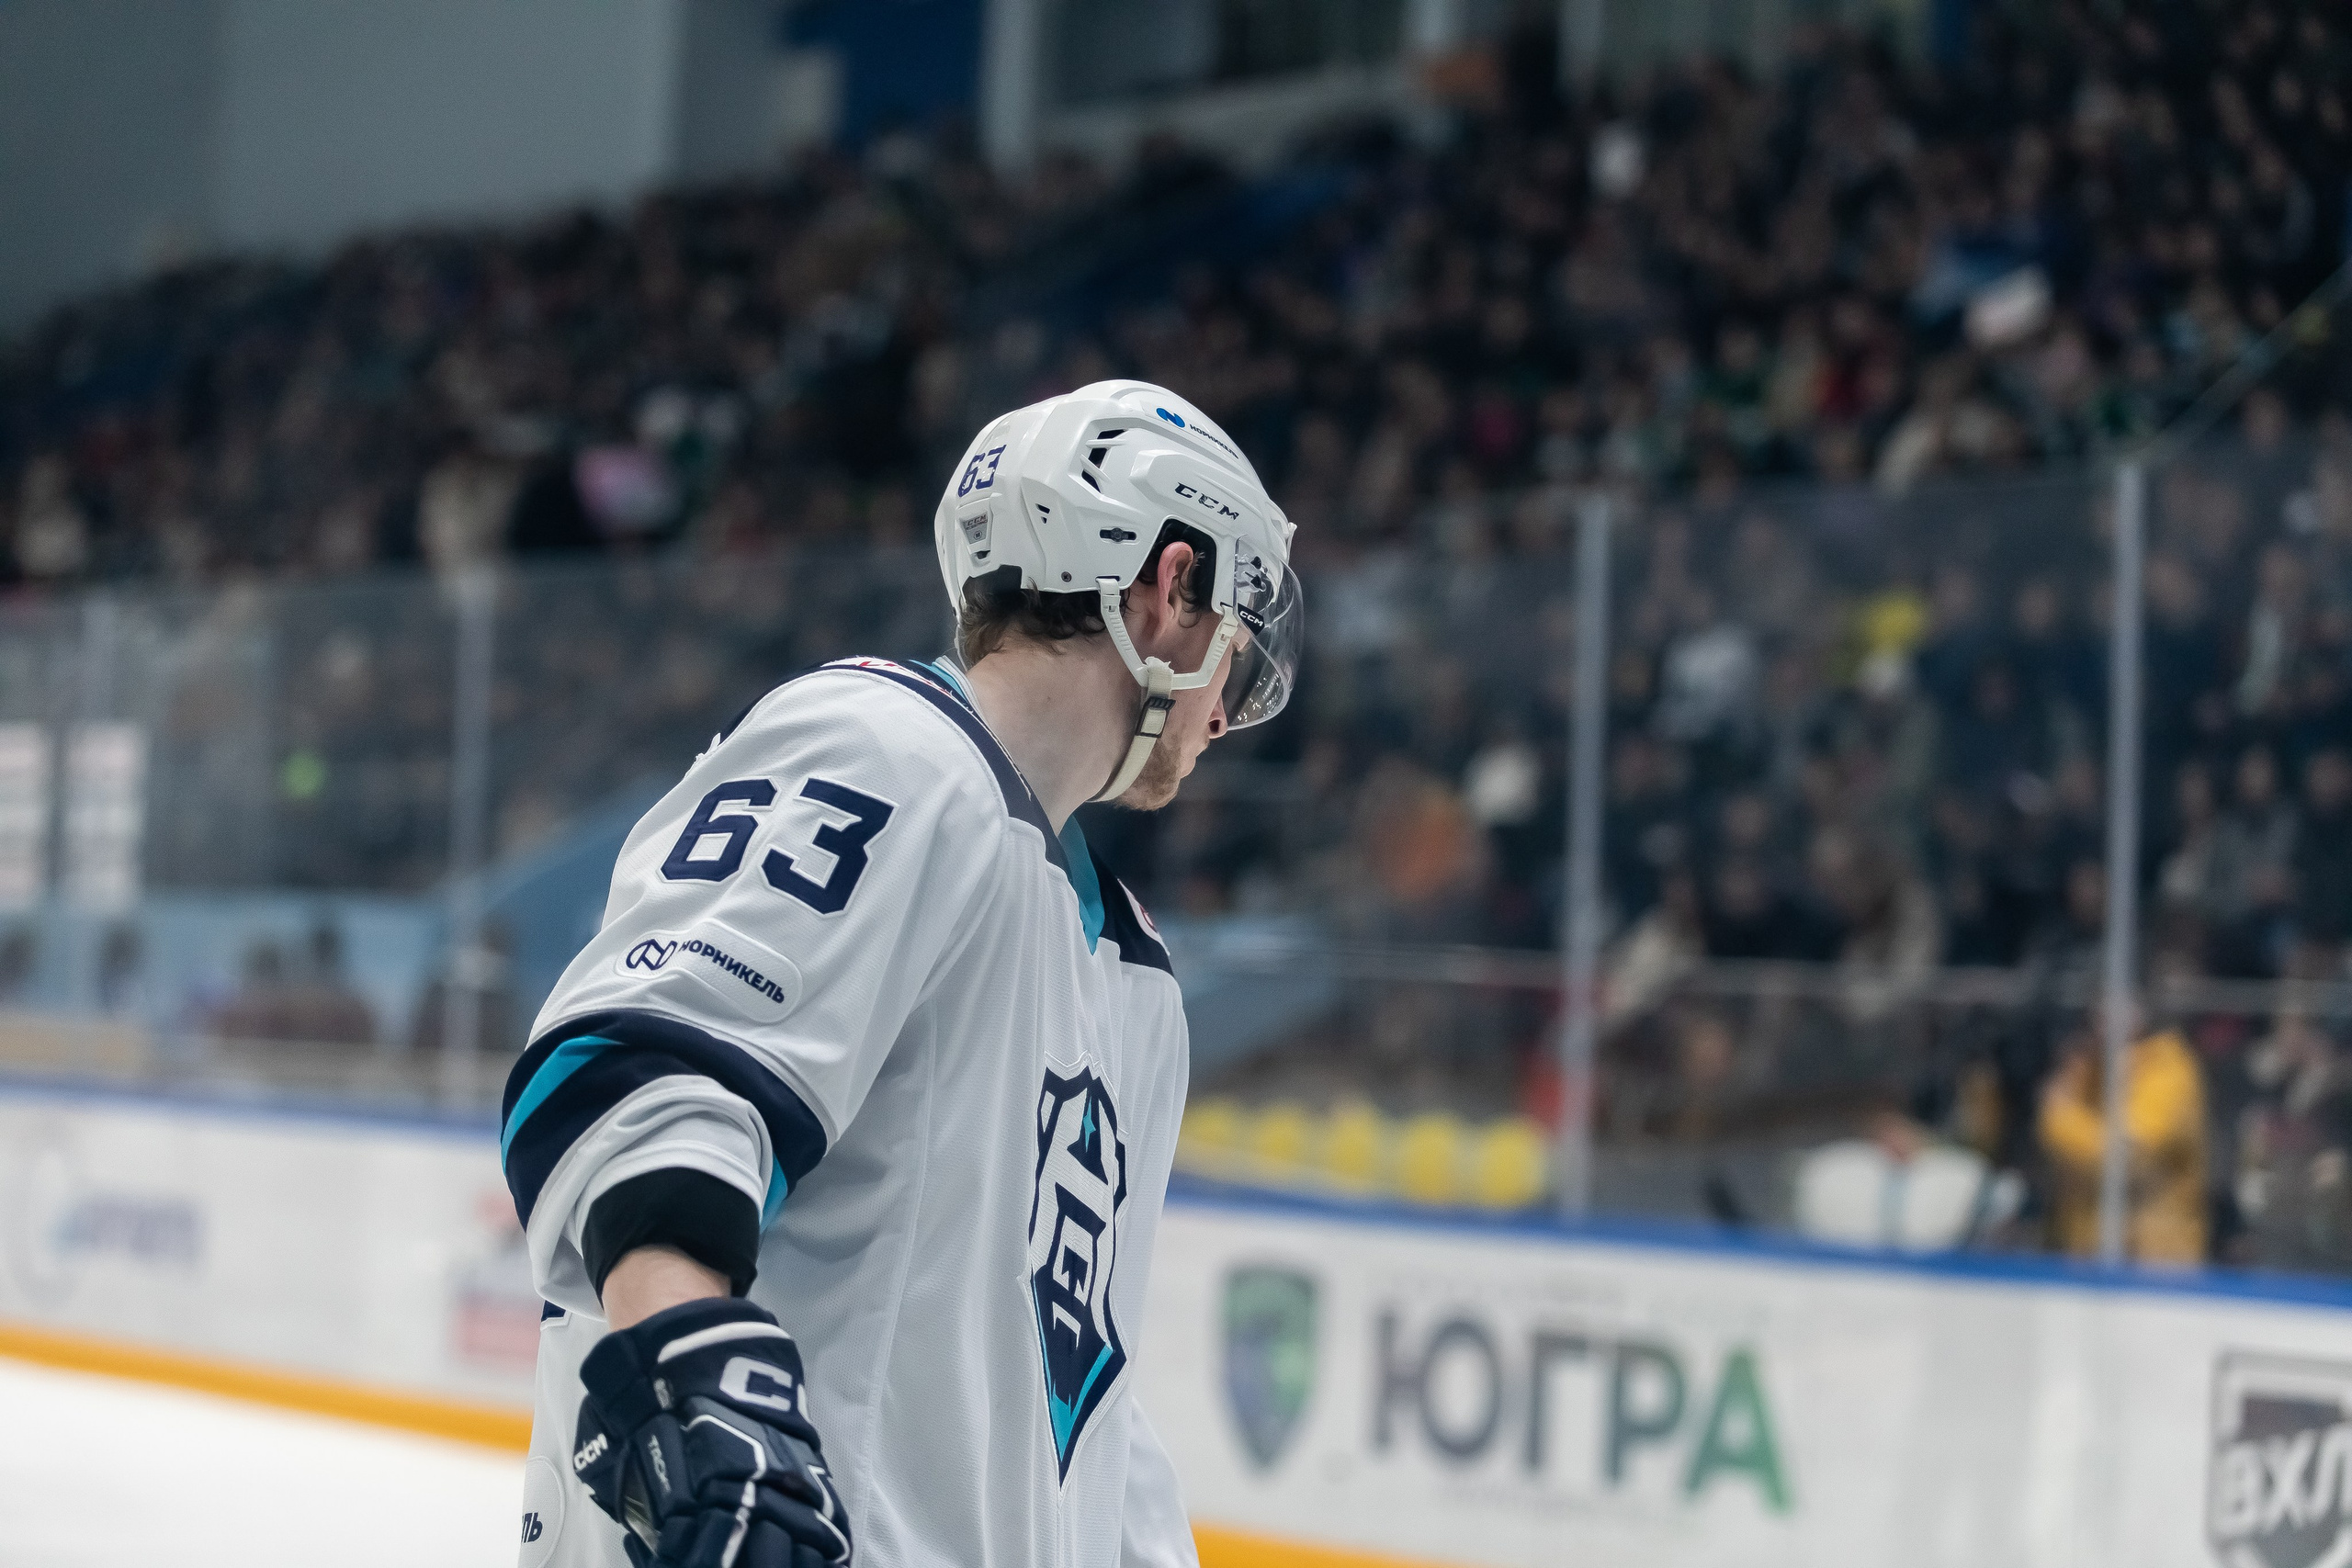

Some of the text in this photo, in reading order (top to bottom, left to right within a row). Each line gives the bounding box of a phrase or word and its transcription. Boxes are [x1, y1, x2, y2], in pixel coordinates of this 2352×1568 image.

[957, 444, 1007, 498] 63
[1174, 481, 1240, 521] CCM
[1239, 610, 1264, 626] CCM
[660, 777, 896, 915] 63
[718, 1356, 808, 1423] C
[1373, 1306, 1795, 1516] ЮГРА
[573, 1433, 608, 1471] CCM
